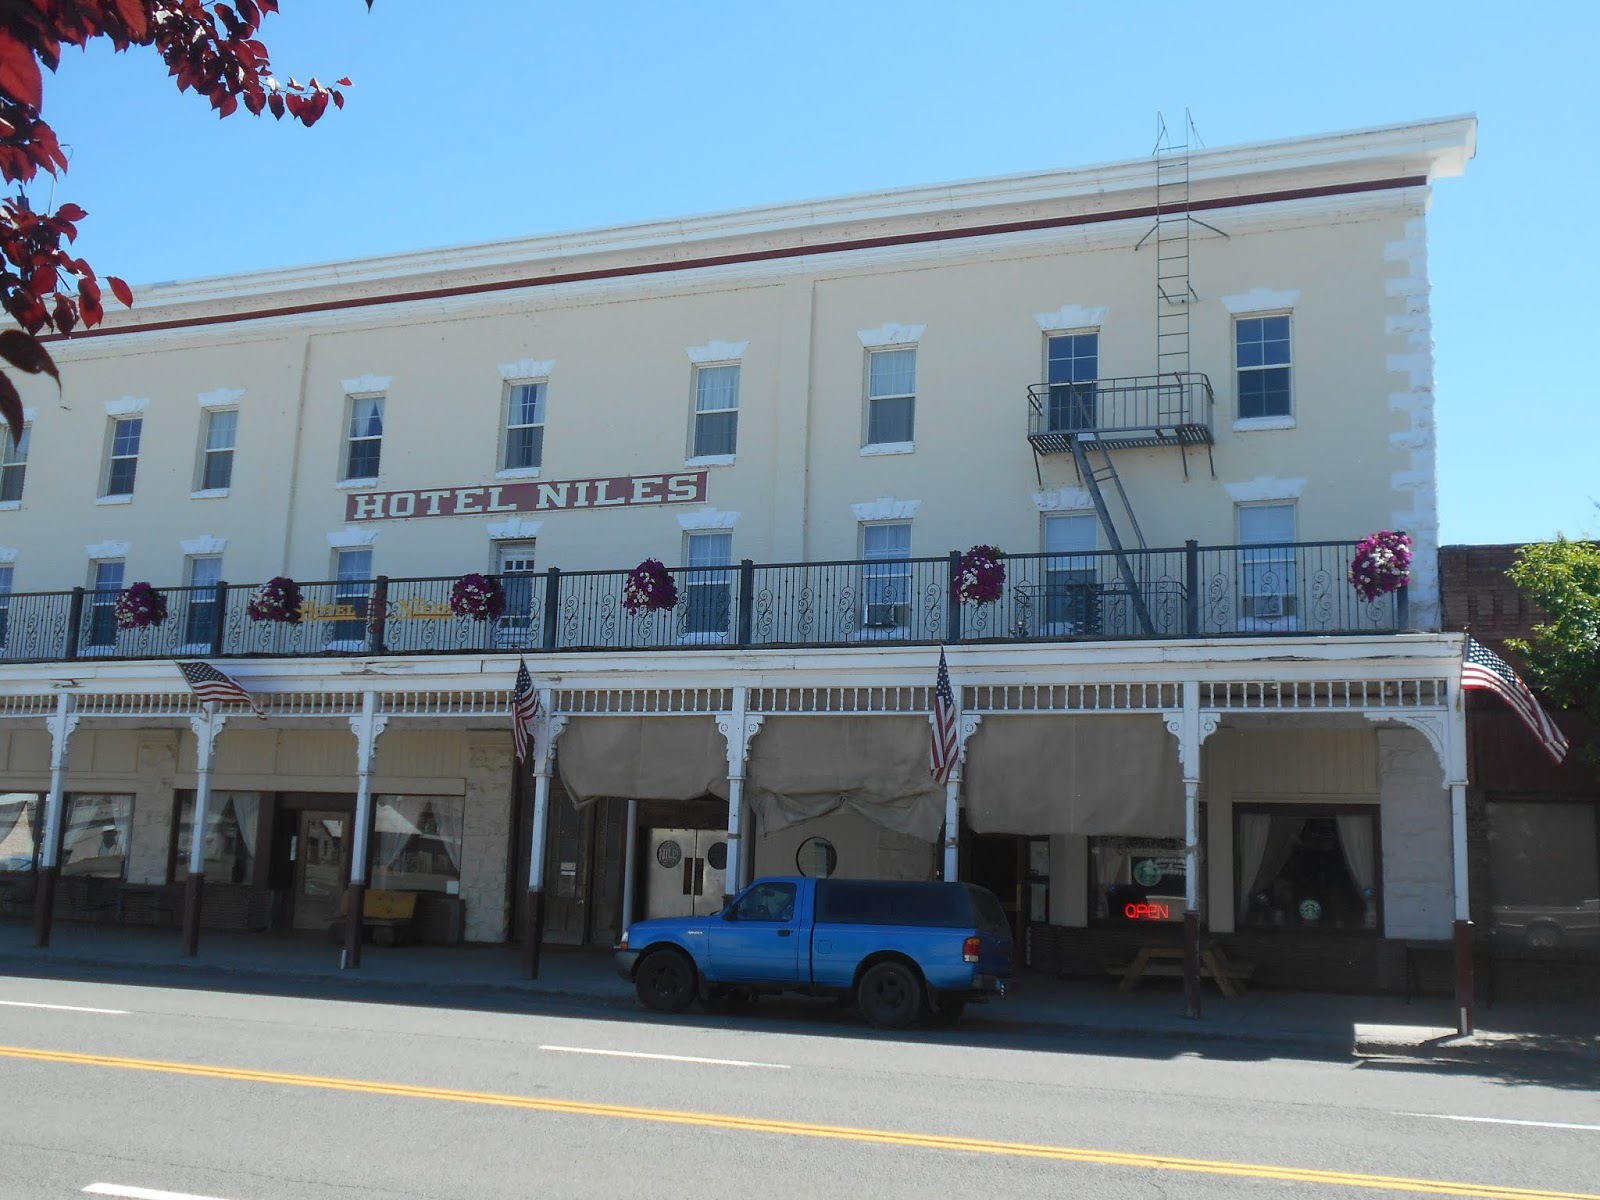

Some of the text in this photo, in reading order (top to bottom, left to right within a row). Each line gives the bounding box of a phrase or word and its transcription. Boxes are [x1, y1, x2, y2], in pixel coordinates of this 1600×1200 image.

[354, 475, 697, 519] HOTEL NILES
[1124, 903, 1169, 919] OPEN
